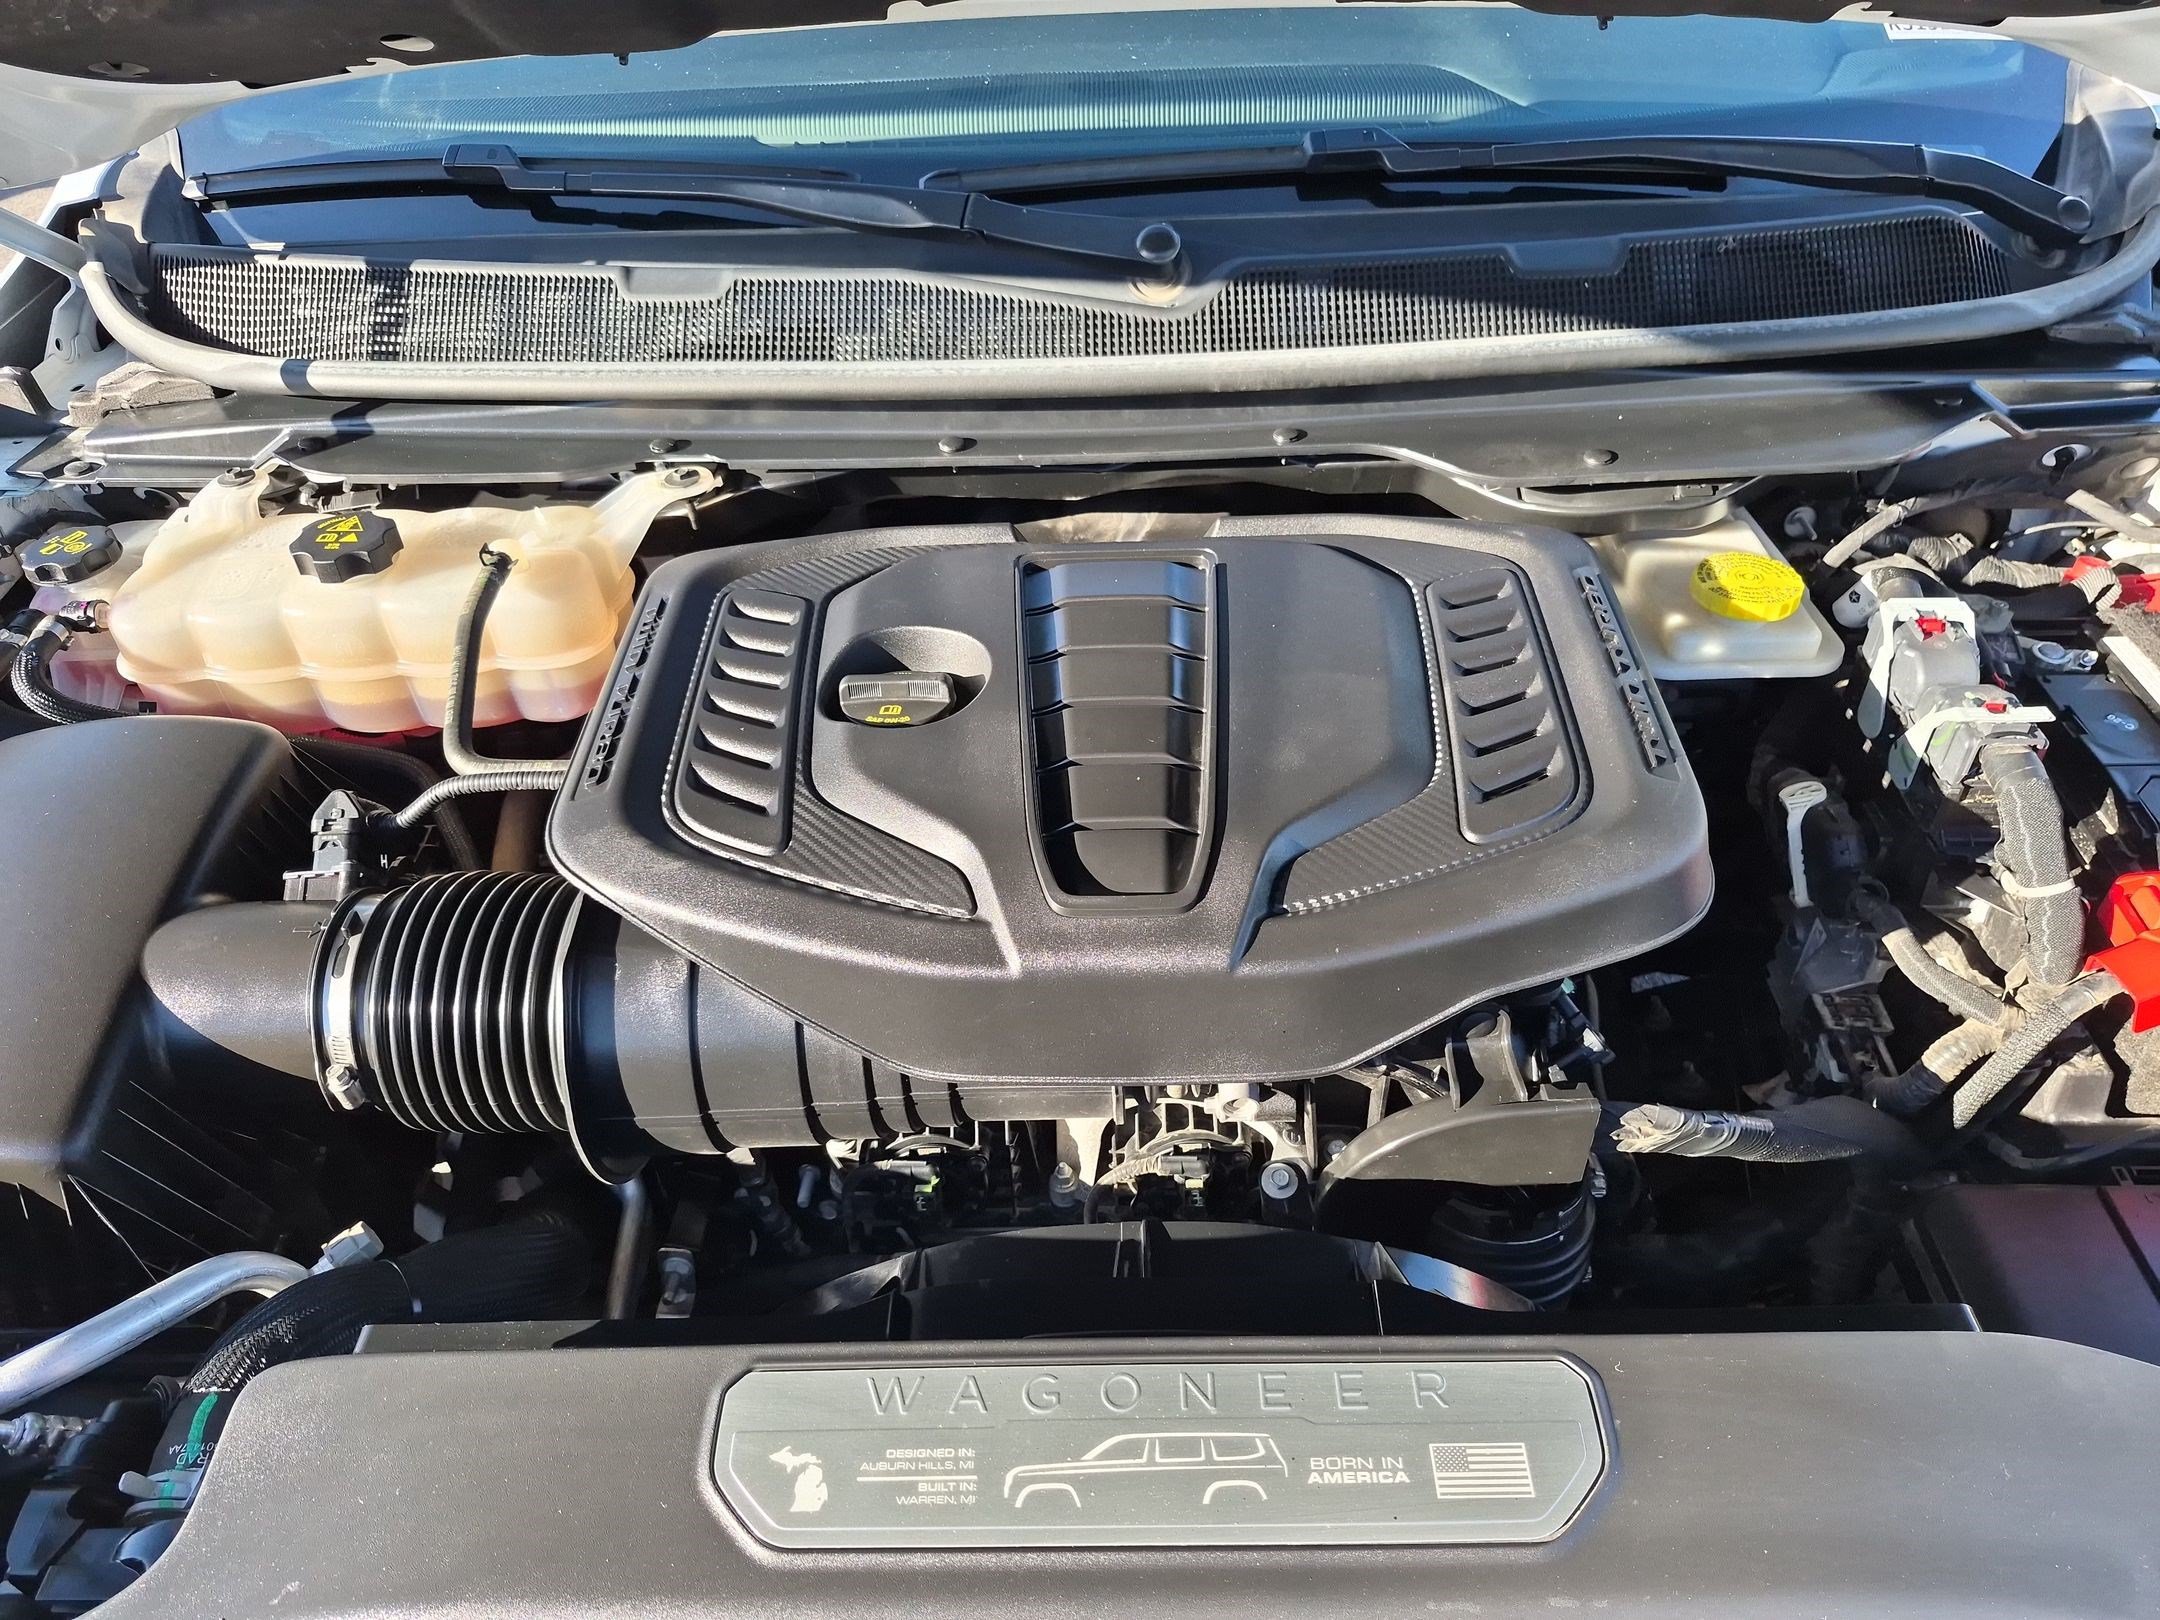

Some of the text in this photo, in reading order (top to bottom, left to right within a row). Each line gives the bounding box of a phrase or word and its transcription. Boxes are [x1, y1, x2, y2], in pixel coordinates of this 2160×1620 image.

[866, 1371, 1449, 1416] WAGONEER
[886, 1448, 976, 1459] DESIGNED IN:
[859, 1460, 975, 1471] AUBURN HILLS, MI
[1310, 1456, 1404, 1470] BORN IN
[1307, 1471, 1411, 1485] AMERICA
[917, 1482, 977, 1492] BUILT IN:
[895, 1495, 976, 1506] WARREN, MI
